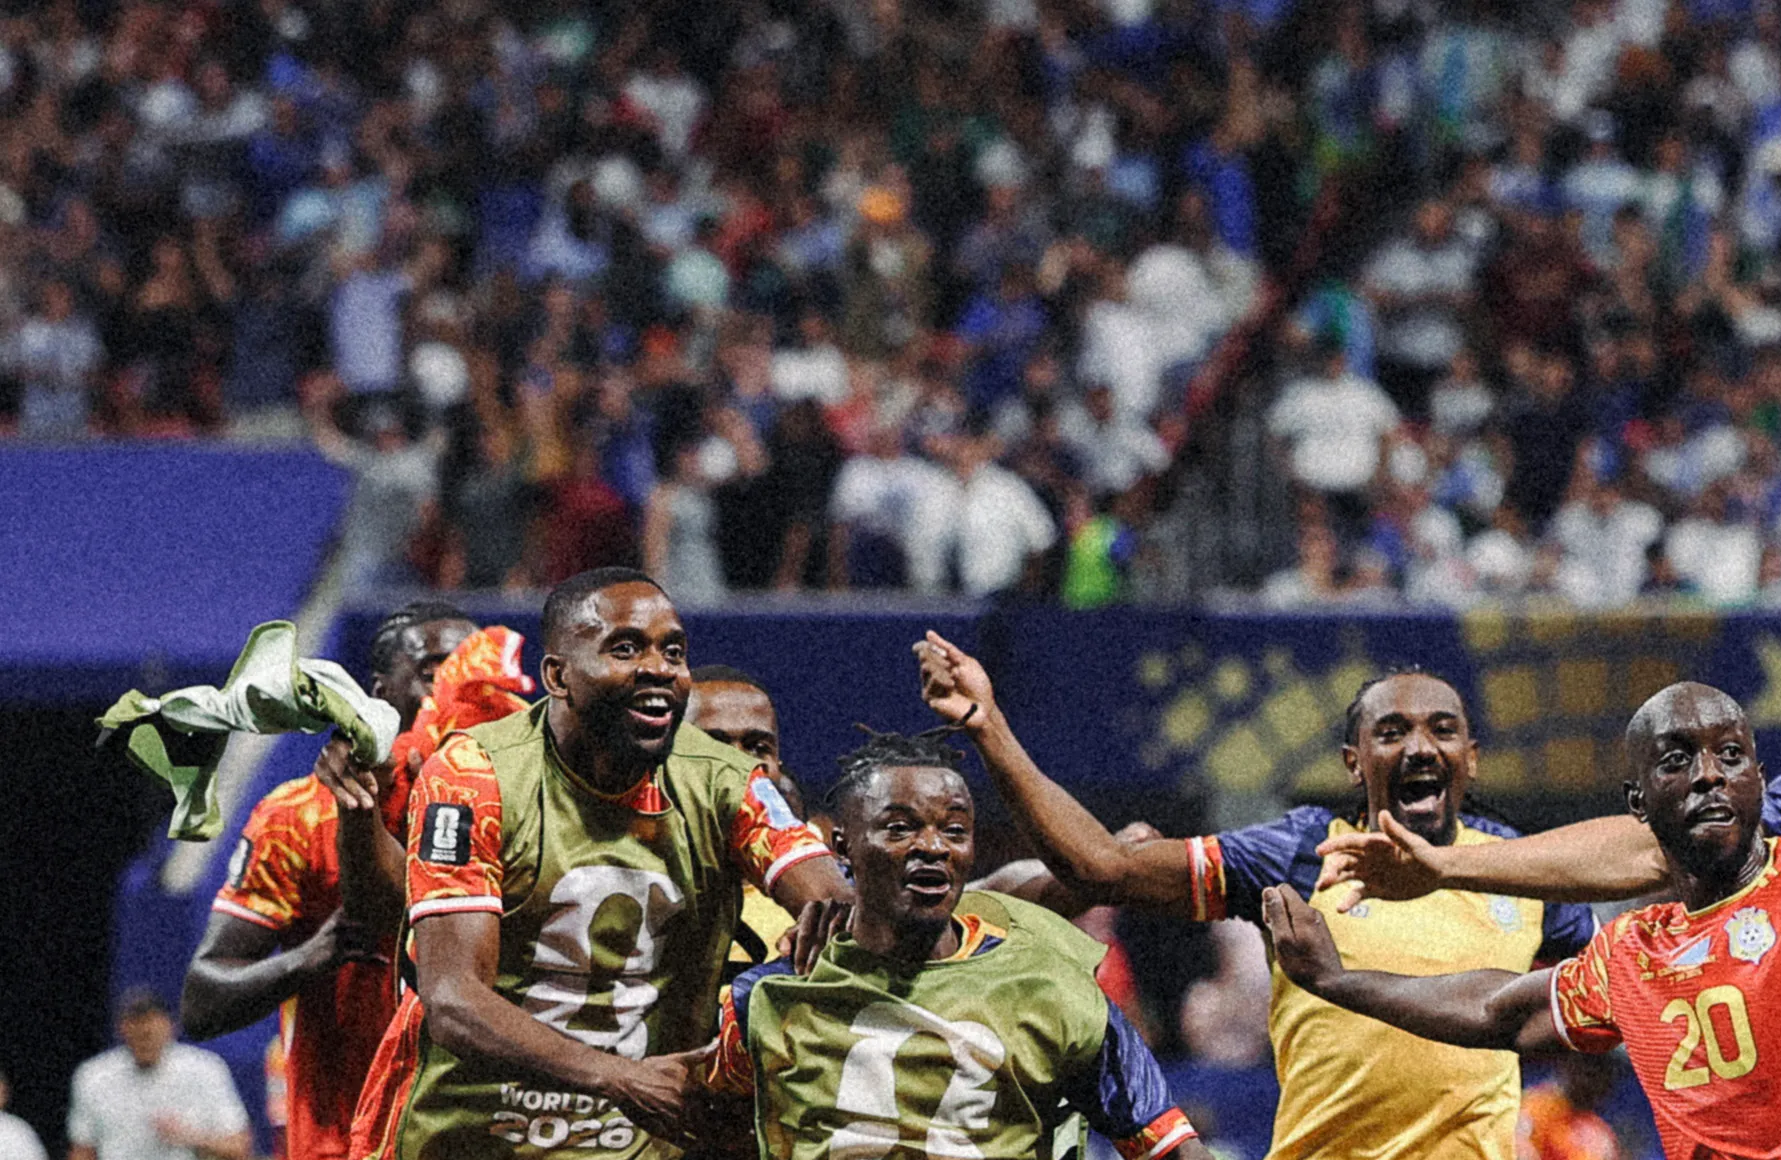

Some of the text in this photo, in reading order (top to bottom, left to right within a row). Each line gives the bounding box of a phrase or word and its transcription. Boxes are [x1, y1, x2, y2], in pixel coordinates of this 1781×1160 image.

[1660, 985, 1757, 1090] 20
[500, 1084, 594, 1114] WORLD
[490, 1111, 634, 1149] 2026
